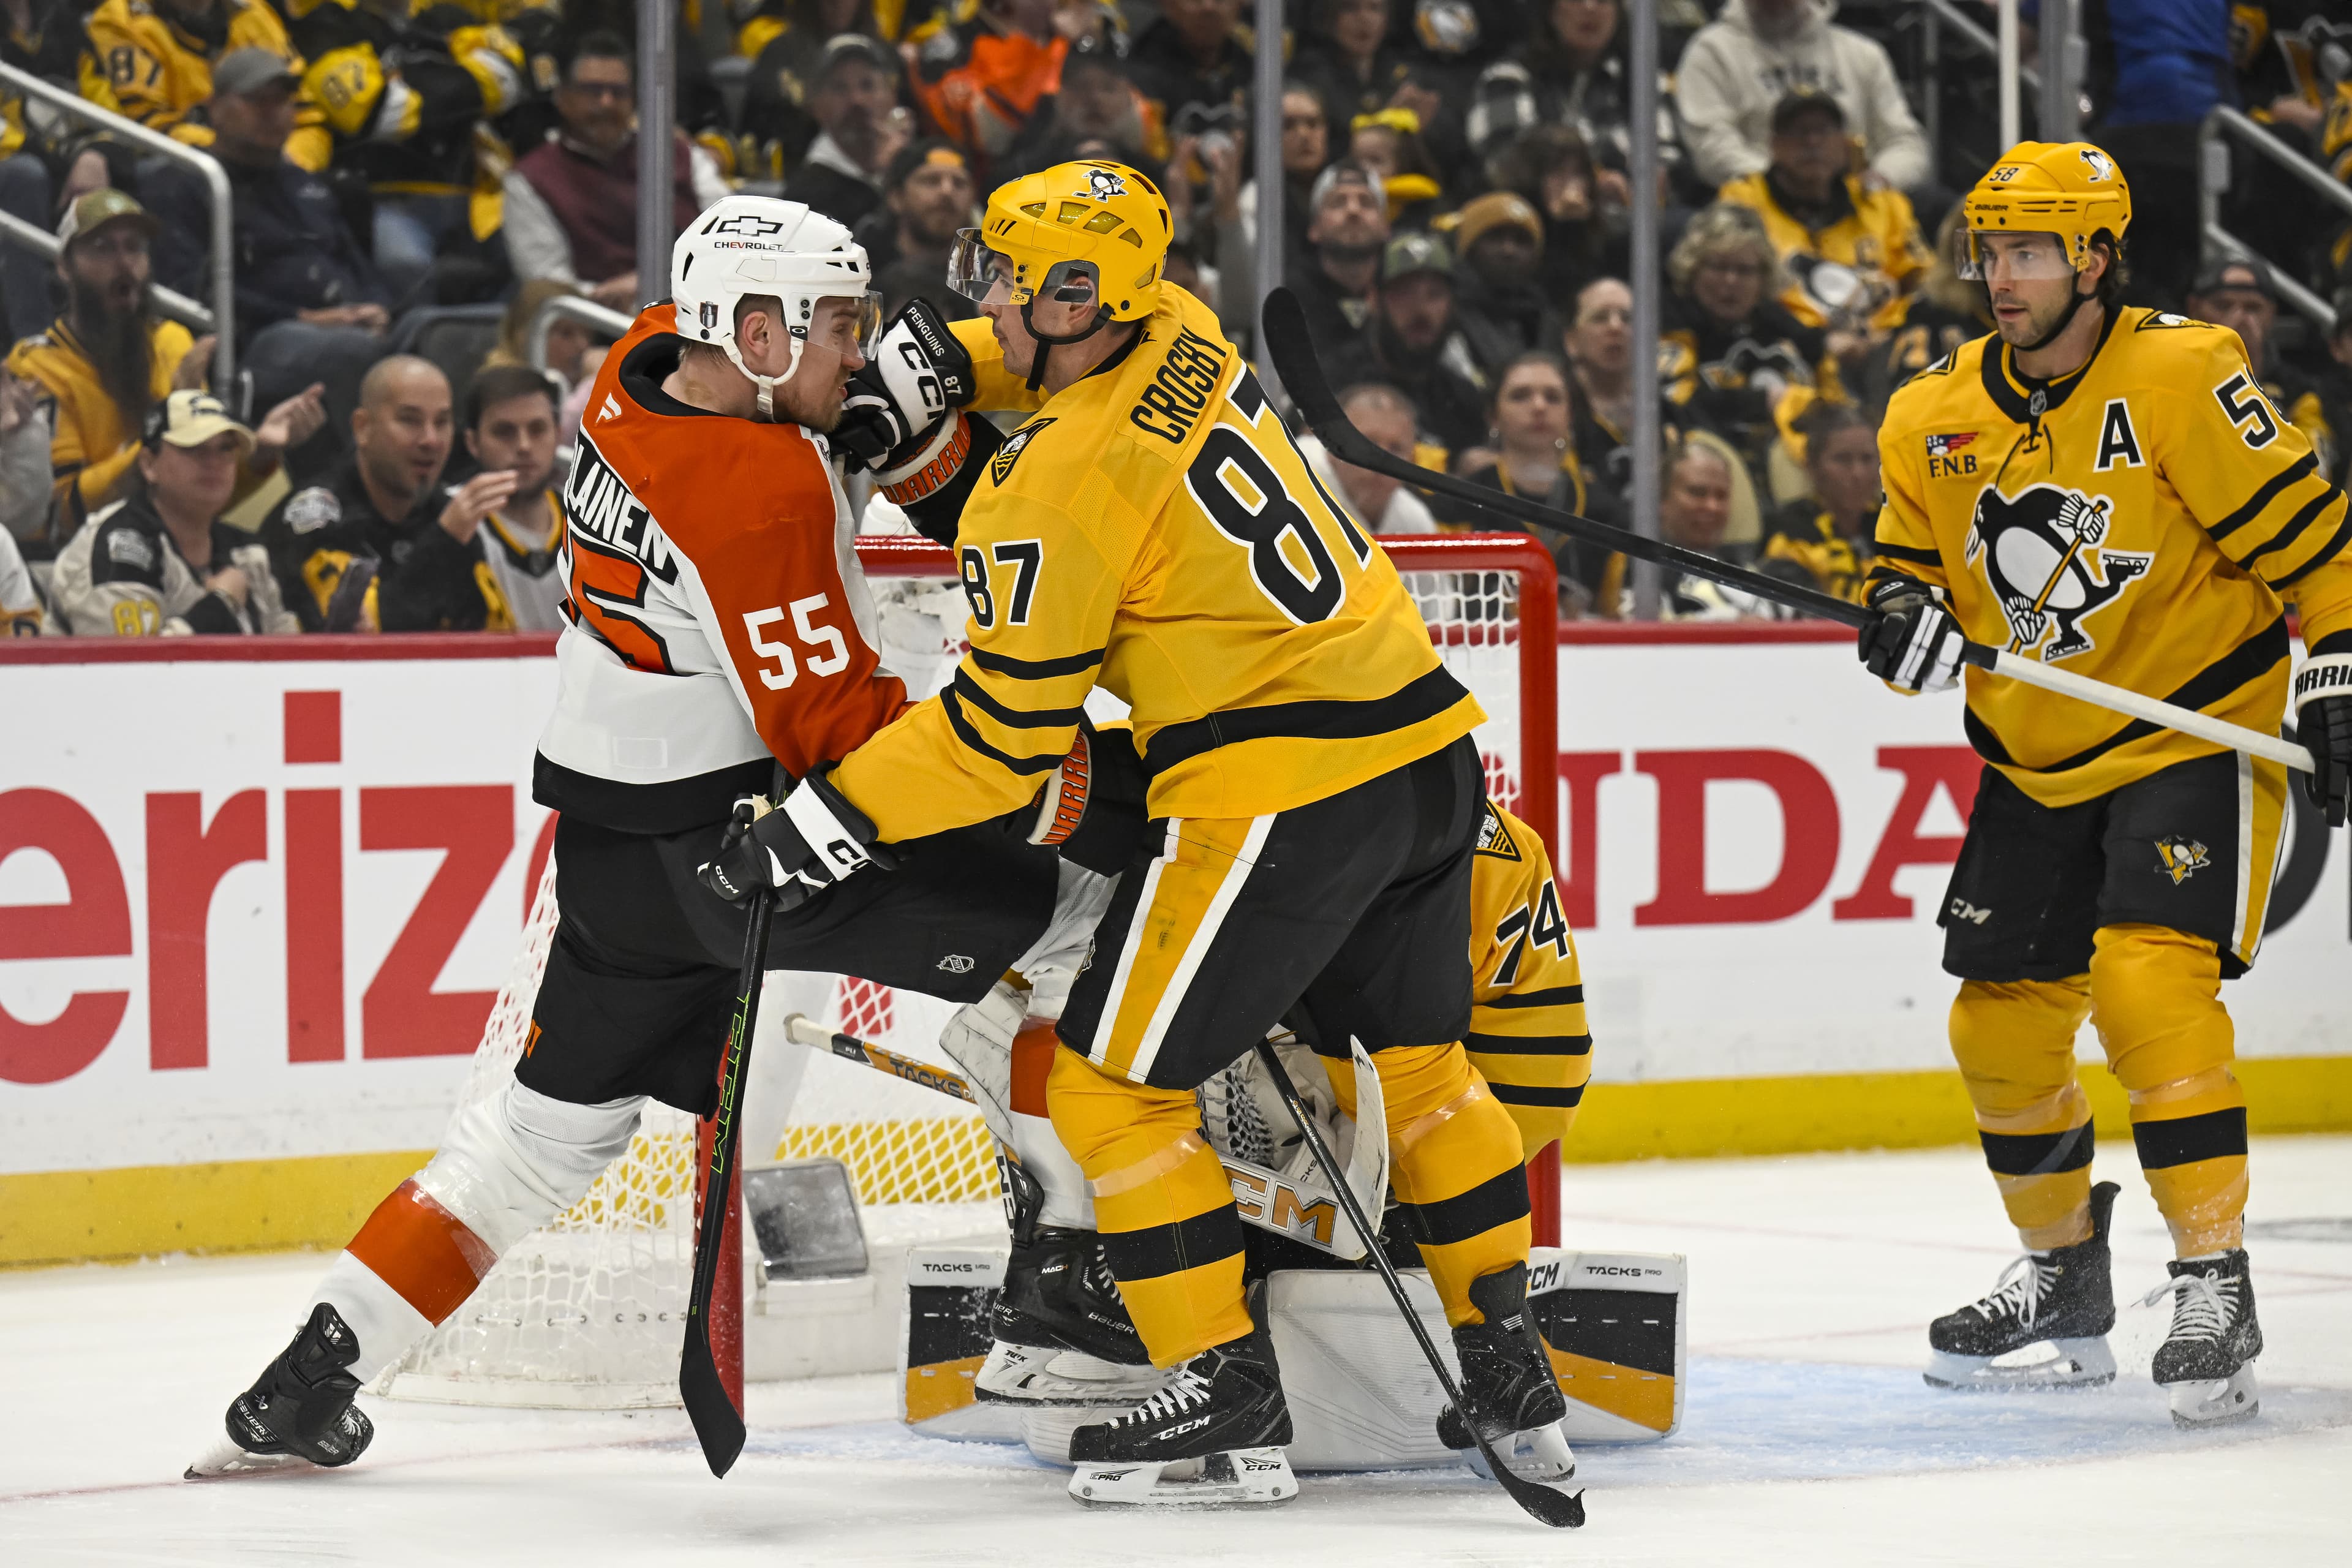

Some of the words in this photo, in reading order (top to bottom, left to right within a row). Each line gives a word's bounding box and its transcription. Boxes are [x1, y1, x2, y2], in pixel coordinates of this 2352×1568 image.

[1989, 167, 2019, 182] 58
[714, 241, 783, 251] CHEVROLET
[907, 306, 945, 357] PENGUINS
[944, 375, 963, 395] 87
[1130, 323, 1227, 445] CROSBY
[2212, 370, 2292, 451] 5
[2094, 398, 2146, 472] A
[1183, 360, 1373, 628] 87
[961, 537, 1044, 631] 87
[742, 592, 851, 691] 55
[0, 690, 559, 1085] eriz
[715, 864, 739, 894] CCM
[1488, 876, 1572, 988] 74
[889, 1059, 963, 1099] TACKS
[922, 1264, 973, 1272] TACKS
[1041, 1264, 1068, 1274] MACH
[1586, 1266, 1641, 1276] TACKS
[1158, 1414, 1212, 1441] CCM
[1244, 1463, 1282, 1471] CCM
